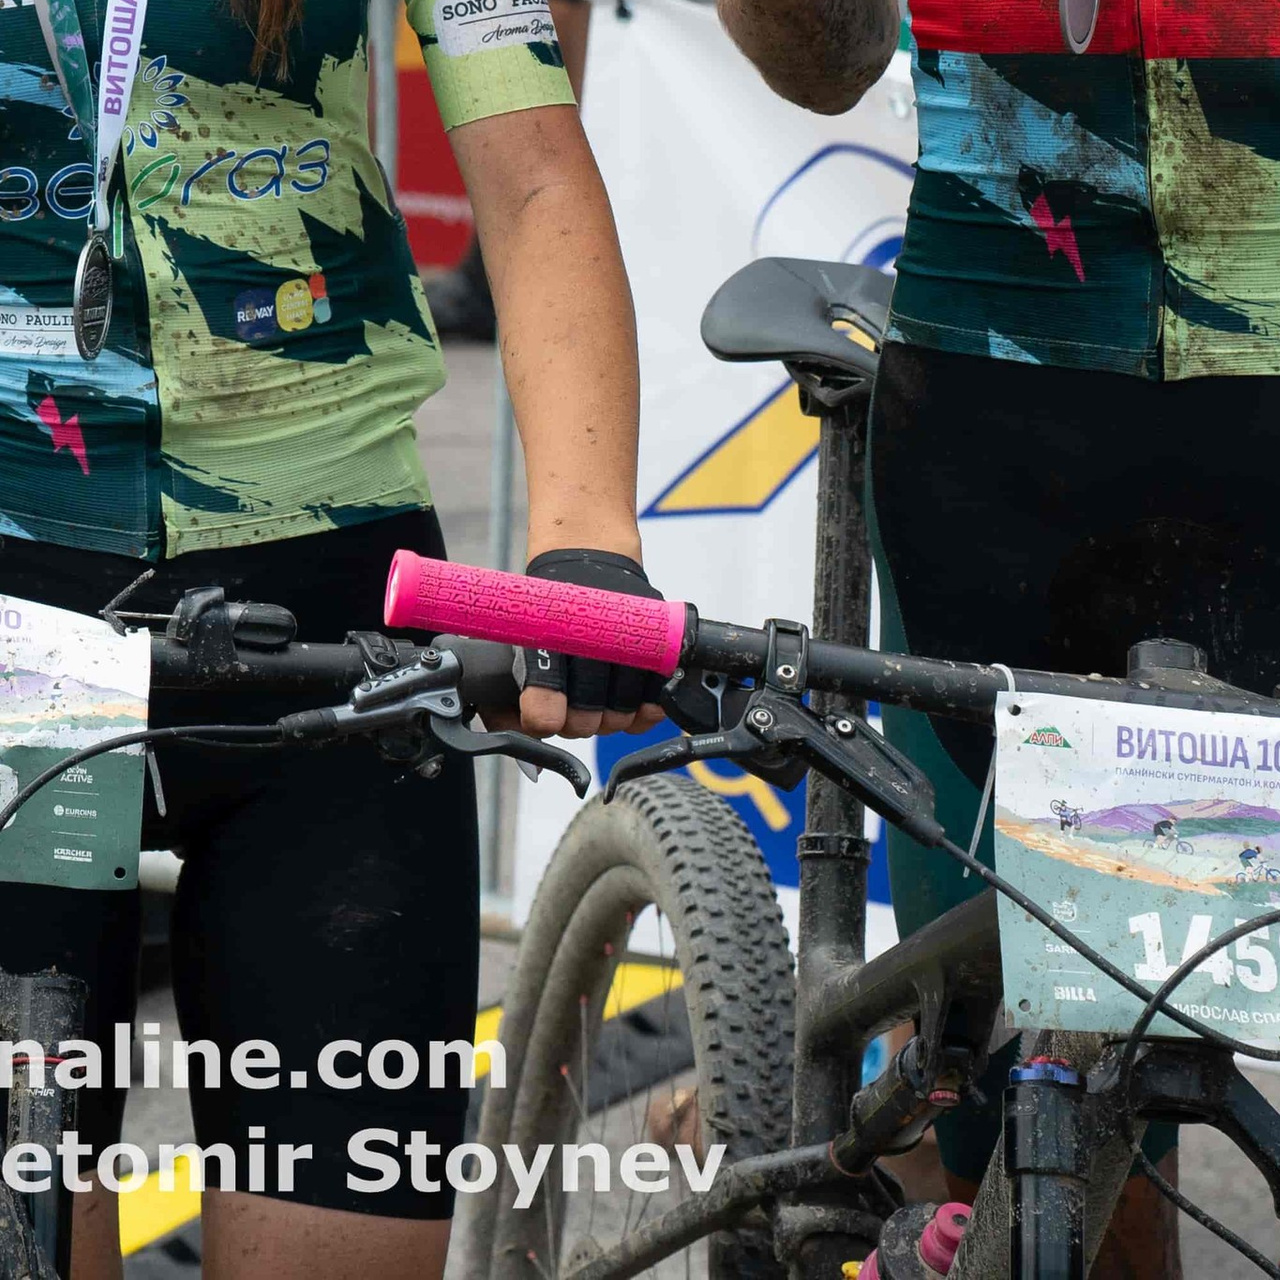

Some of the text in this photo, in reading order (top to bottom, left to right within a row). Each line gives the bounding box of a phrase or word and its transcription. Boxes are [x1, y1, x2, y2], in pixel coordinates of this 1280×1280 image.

[692, 736, 725, 747] SRAM
[1116, 725, 1250, 770] ВИТОША
[1116, 766, 1175, 780] ПЛАНИНСКИ
[1177, 772, 1252, 788] СУПЕРМАРАТОН
[1053, 985, 1097, 1002] BILLA
